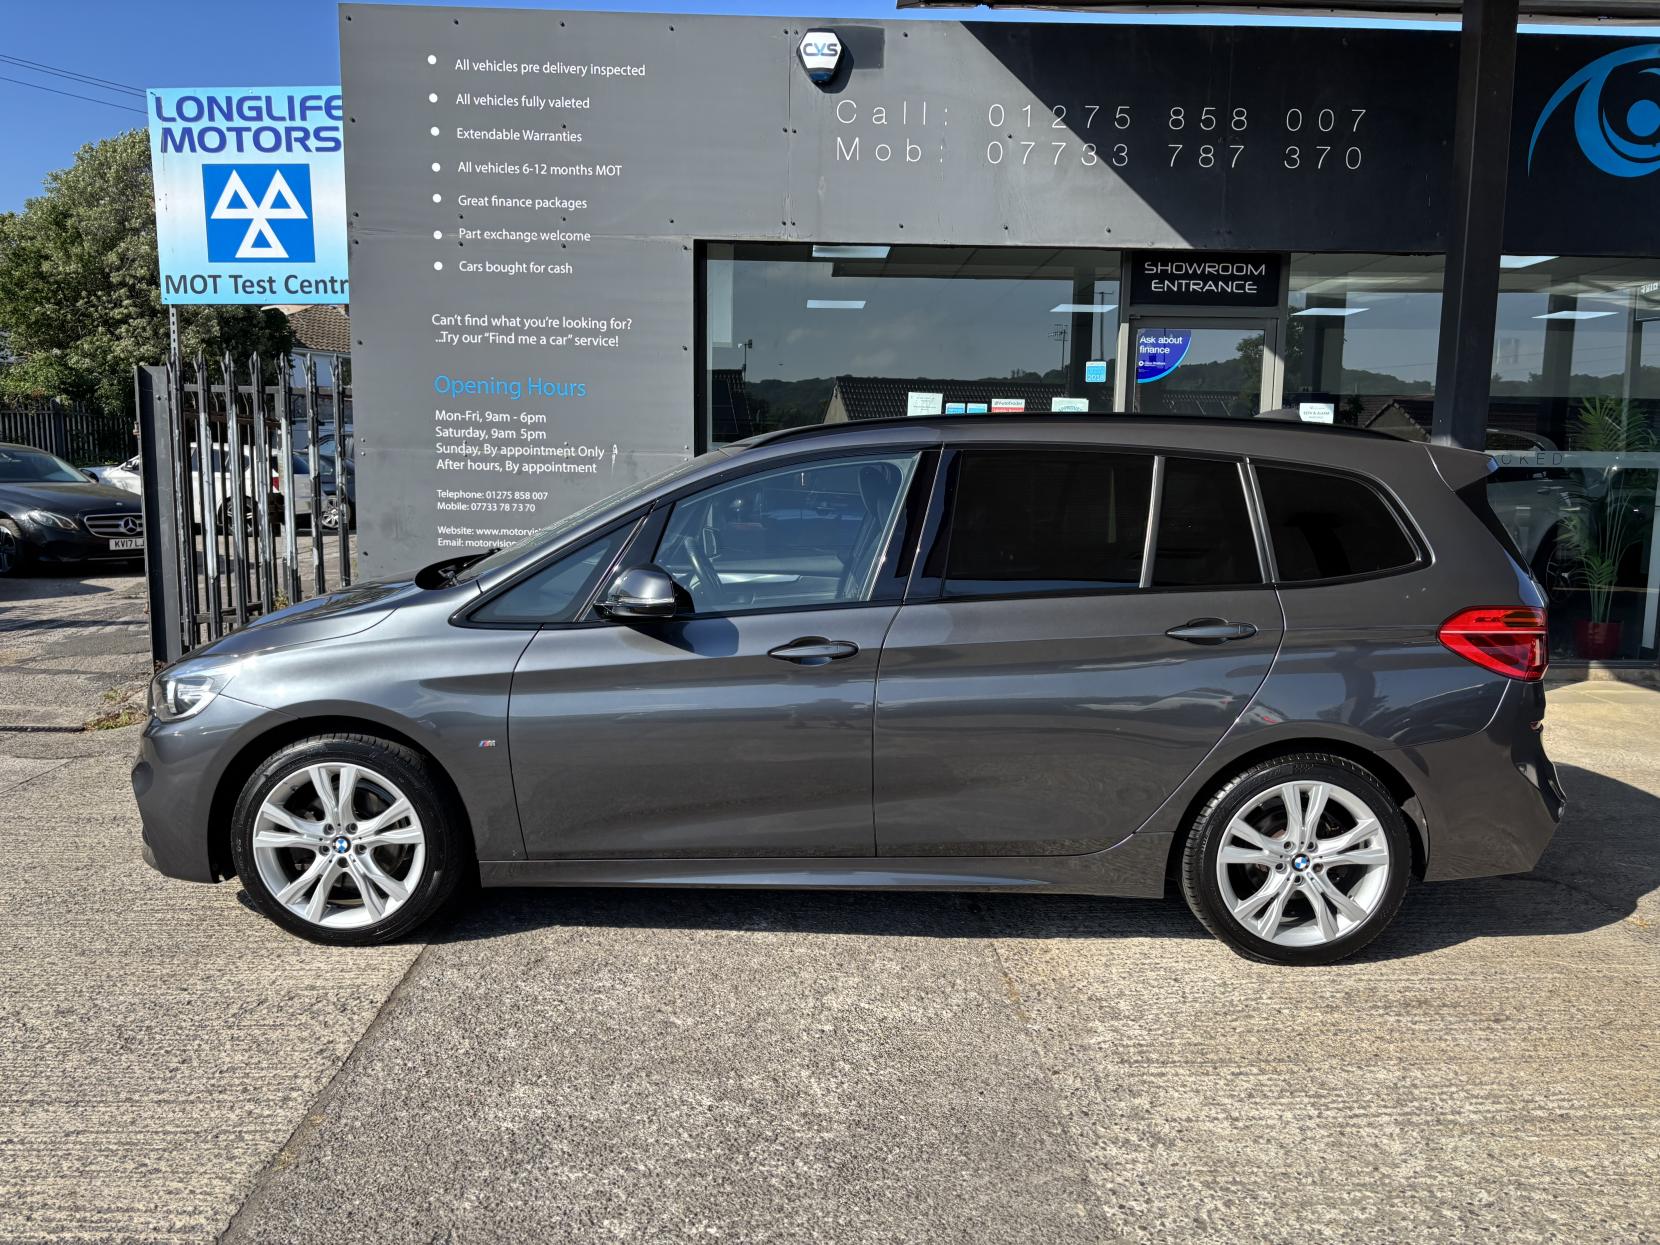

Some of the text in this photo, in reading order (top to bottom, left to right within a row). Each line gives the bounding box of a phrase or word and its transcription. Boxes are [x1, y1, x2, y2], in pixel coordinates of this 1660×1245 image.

[455, 59, 469, 71] All
[472, 60, 518, 72] vehicles
[521, 64, 540, 75] pre
[542, 62, 588, 77] delivery
[155, 95, 343, 122] LONGLIFE
[456, 94, 590, 110] All vehicles fully valeted
[988, 103, 1131, 129] 01275
[1168, 107, 1248, 131] 858
[1286, 109, 1366, 132] 007
[160, 126, 343, 153] MOTORS
[456, 128, 583, 142] Extendable Warranties
[987, 141, 1128, 166] 07733
[1168, 144, 1244, 168] 787
[1284, 146, 1362, 169] 370
[458, 161, 622, 176] All vehicles 6-12 months MOT
[458, 195, 588, 210] Great finance packages
[458, 228, 591, 242] Part exchange welcome
[459, 261, 573, 276] Cars bought for cash
[1144, 261, 1265, 275] SHOWROOM
[165, 274, 222, 294] MOT
[228, 274, 277, 294] Test
[1151, 279, 1258, 293] ENTRANCE
[464, 314, 488, 326] find
[491, 315, 521, 327] what
[562, 316, 607, 332] looking
[609, 318, 632, 330] for?
[462, 334, 482, 344] our
[518, 335, 537, 345] me
[539, 335, 547, 345] a
[574, 335, 619, 347] service!
[1139, 335, 1183, 344] Ask about
[1139, 345, 1170, 354] finance
[433, 375, 587, 400] Opening Hours
[435, 409, 483, 423] Mon-Fri,
[485, 411, 511, 422] 9am
[520, 412, 547, 425] 6pm
[435, 426, 547, 441] Saturday, 9am 5pm
[435, 442, 604, 460] Sunday, By appointment Only
[436, 459, 597, 474] After hours, By appointment
[436, 489, 549, 500] Telephone: 01275 858 007
[437, 502, 470, 511] Mobile:
[470, 503, 498, 511] 07733
[437, 526, 474, 535] Website:
[437, 538, 464, 547] Email:
